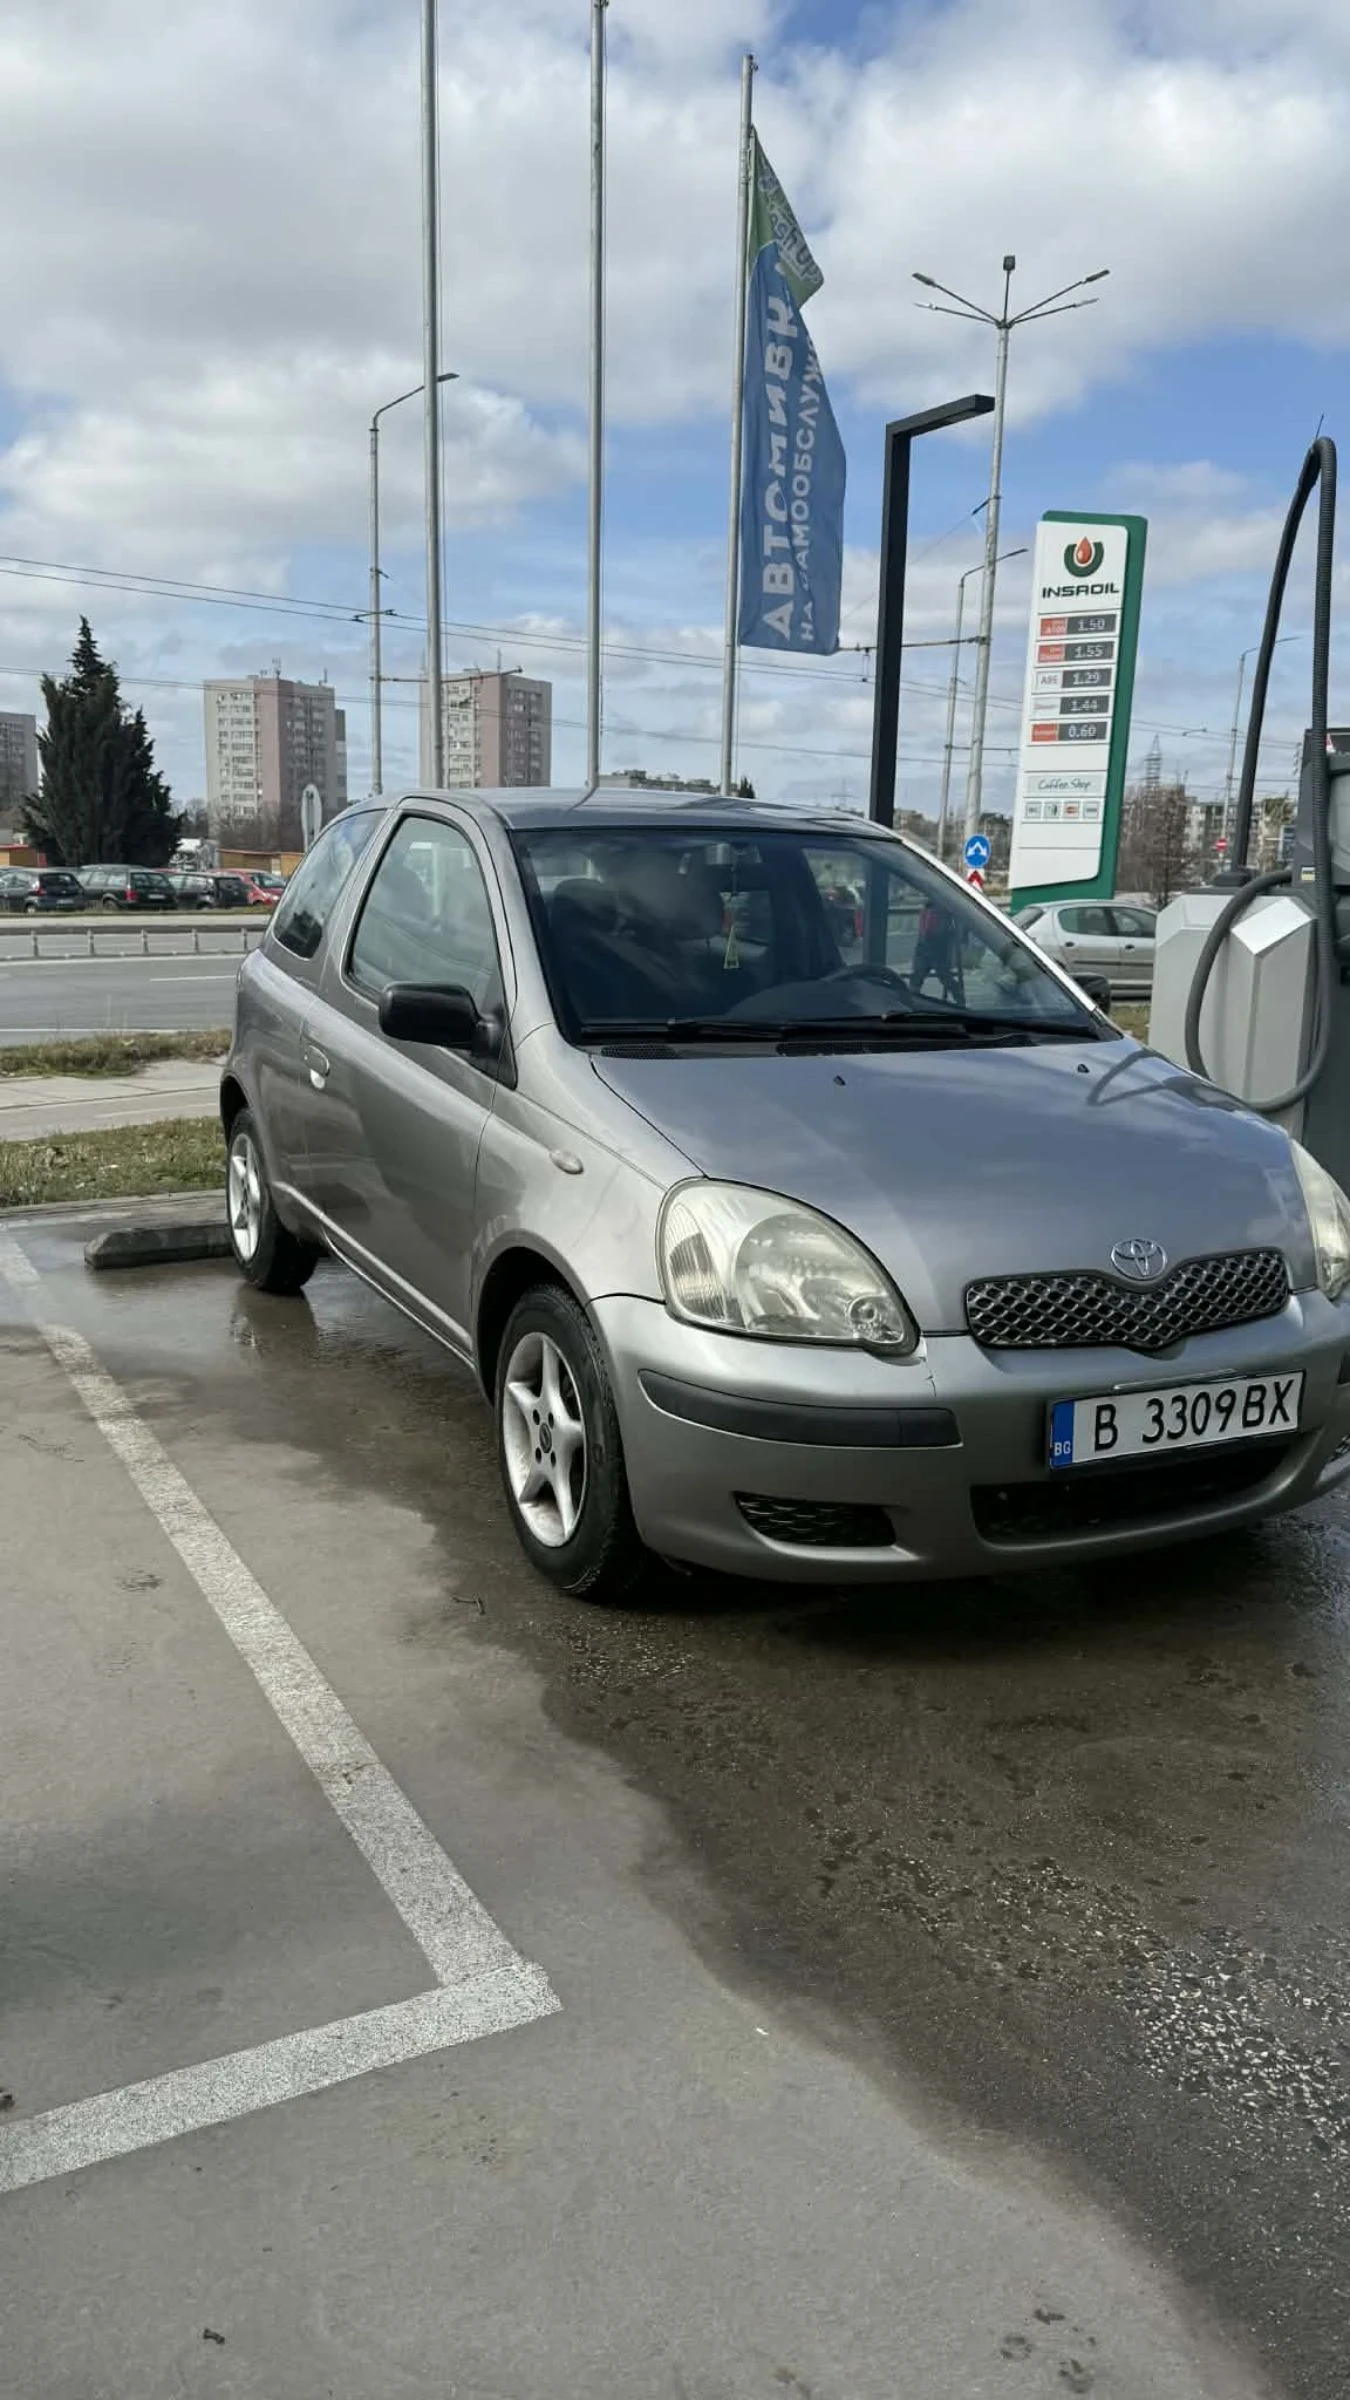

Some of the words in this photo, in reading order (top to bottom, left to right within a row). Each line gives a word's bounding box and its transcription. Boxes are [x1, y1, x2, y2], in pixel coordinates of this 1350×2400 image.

[762, 262, 798, 642] АВТОМИВК
[1042, 583, 1119, 598] INSAOIL
[801, 601, 815, 642] НА
[1078, 619, 1105, 632] 1.50
[1074, 644, 1104, 659] 1.55
[1068, 724, 1096, 738] 0.60
[1094, 1403, 1119, 1453] B
[1053, 1441, 1072, 1457] BG
